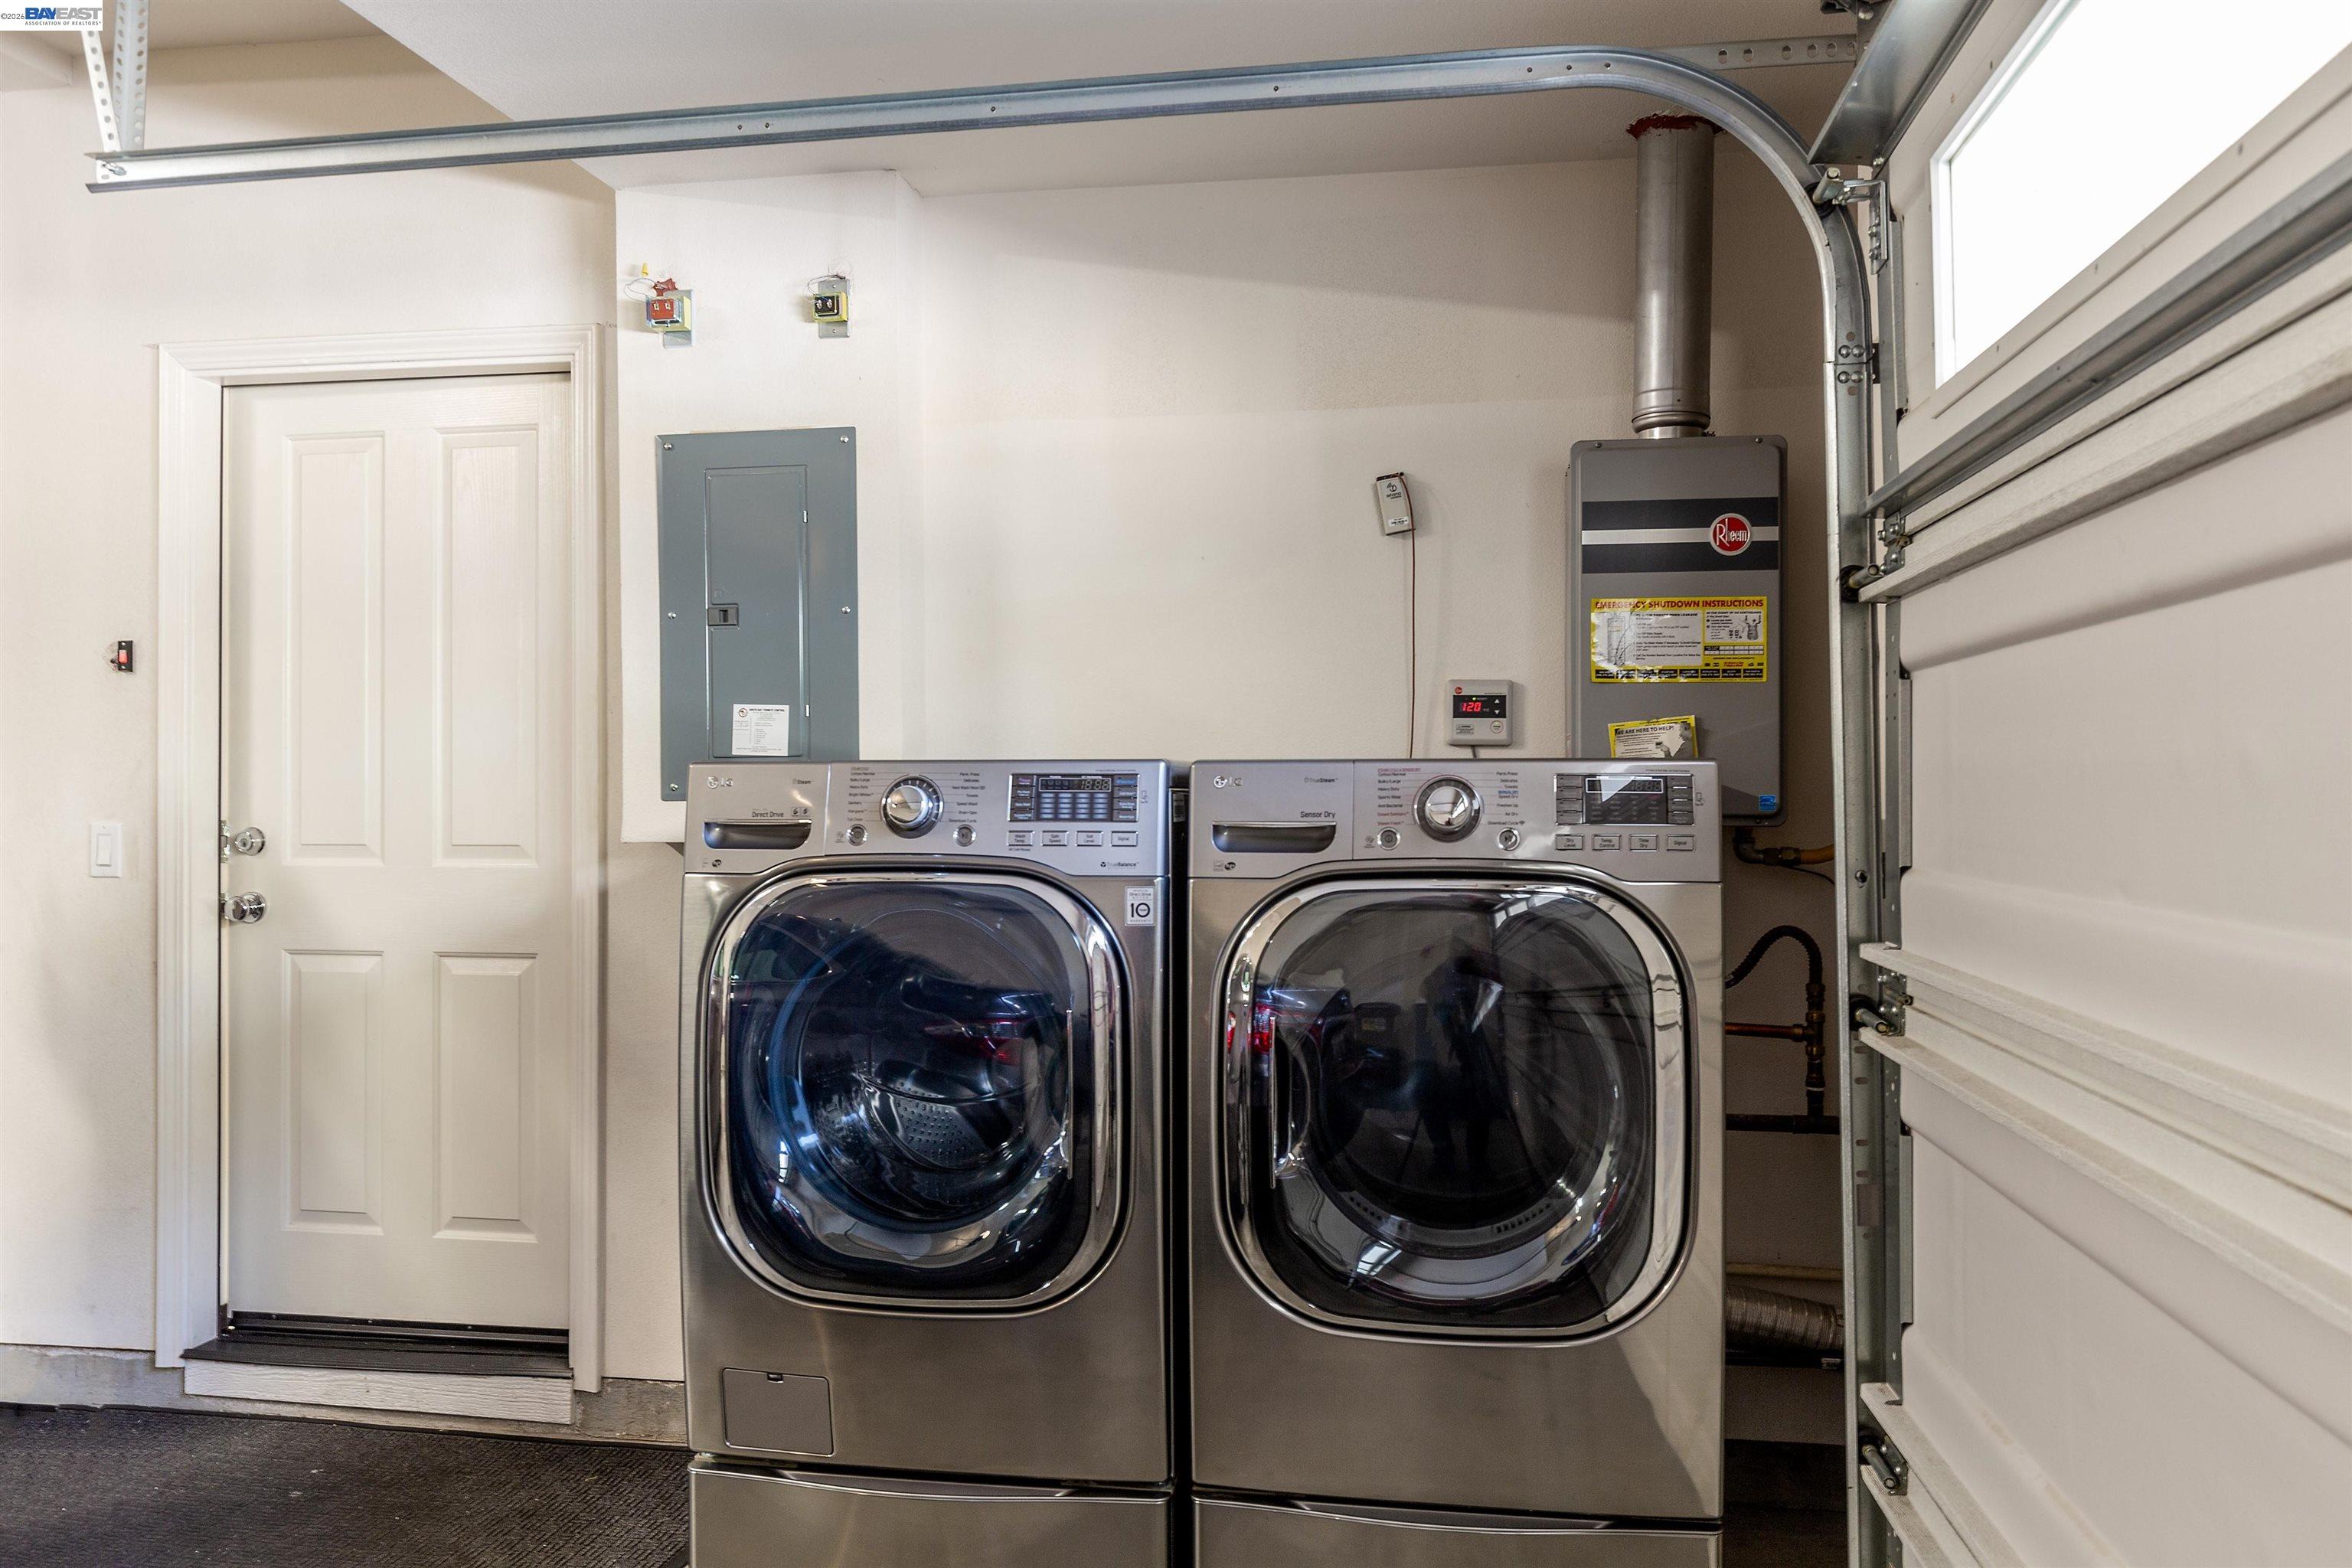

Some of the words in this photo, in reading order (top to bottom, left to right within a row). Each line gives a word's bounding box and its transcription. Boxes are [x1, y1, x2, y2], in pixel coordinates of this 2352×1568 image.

[1717, 518, 1747, 547] Rheem
[1648, 600, 1700, 609] SHUTDOWN
[1702, 599, 1764, 608] INSTRUCTIONS
[1462, 702, 1481, 712] 120
[720, 778, 733, 787] LG
[1131, 903, 1151, 918] 10
